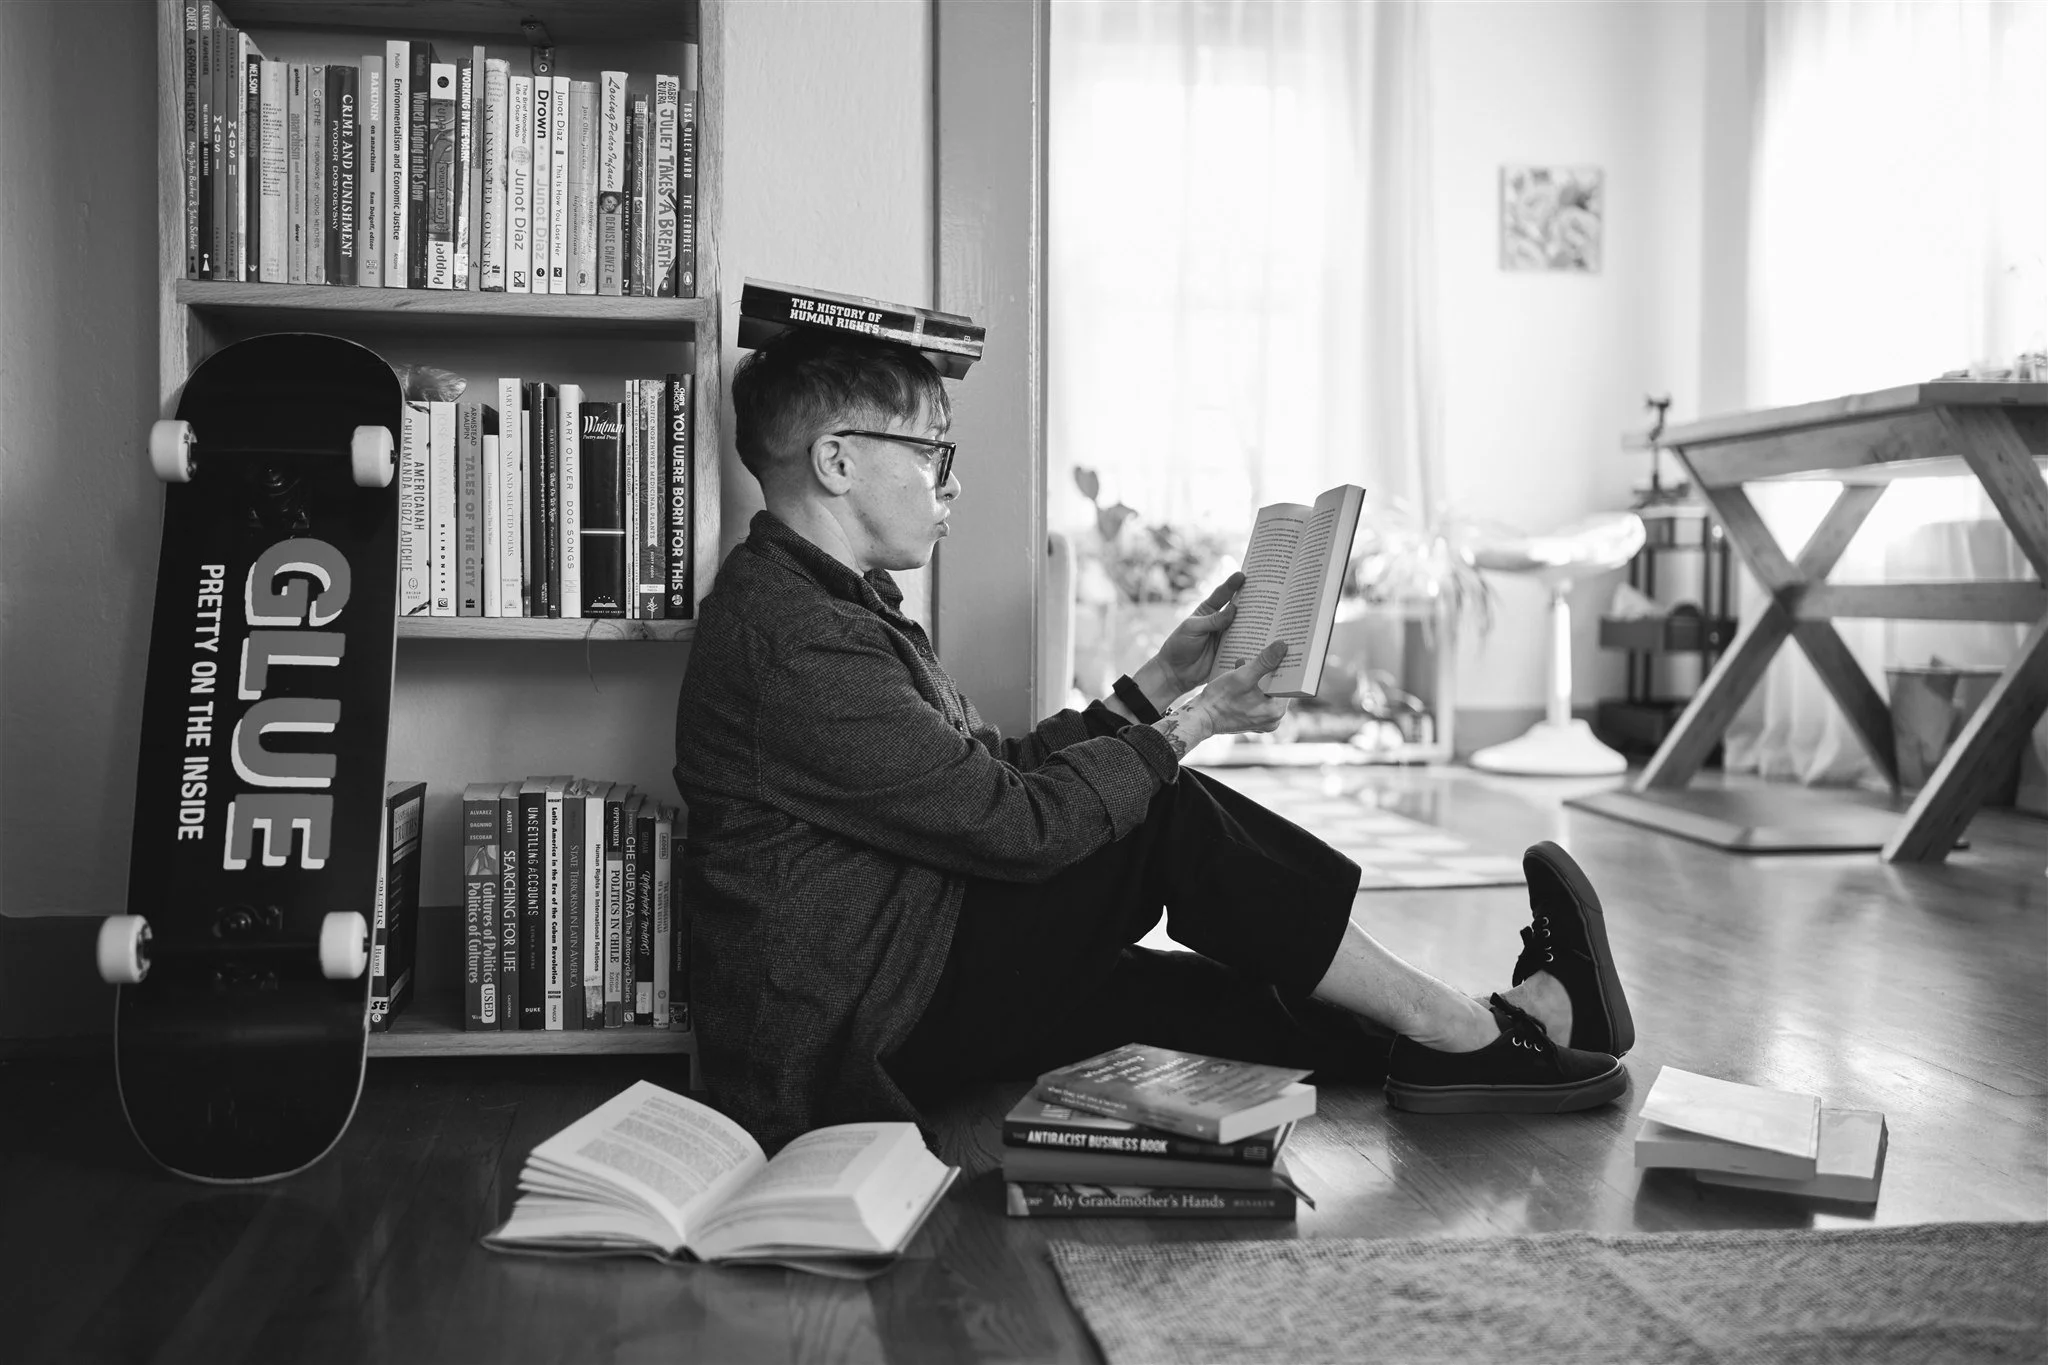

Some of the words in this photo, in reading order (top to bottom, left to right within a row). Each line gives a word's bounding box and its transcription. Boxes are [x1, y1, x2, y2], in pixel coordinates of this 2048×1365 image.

[186, 6, 198, 31] QUEER
[249, 63, 258, 95] NELSON
[461, 67, 471, 110] WORKING
[514, 83, 522, 95] Life
[657, 81, 667, 105] RIVERA
[370, 72, 379, 121] BAKUNIN
[412, 91, 427, 121] Women
[514, 97, 522, 106] of
[556, 91, 566, 117] Junot
[605, 77, 621, 122] Loving
[667, 82, 677, 106] GABBY
[342, 94, 354, 137] CRIME
[393, 78, 403, 152] Environmentalism
[461, 111, 471, 120] IN
[485, 104, 494, 122] MY
[514, 106, 522, 122] Oscar
[537, 90, 549, 139] Drown
[683, 103, 692, 123] YRSA
[214, 114, 222, 152] MAUS
[228, 121, 237, 159] MAUS
[290, 114, 303, 160] anarchism
[370, 125, 376, 134] on
[410, 124, 428, 154] Singing
[461, 121, 471, 139] THE
[514, 124, 522, 138] Wao
[556, 120, 566, 141] Díaz
[607, 123, 618, 151] Pedro
[660, 109, 675, 150] JULIET
[215, 158, 220, 169] I
[342, 141, 353, 169] AND
[369, 136, 377, 173] anarchism
[393, 153, 402, 169] and
[412, 155, 426, 163] in
[461, 139, 471, 162] DARK
[683, 127, 692, 178] DALEY-WARD
[228, 164, 236, 175] II
[412, 165, 427, 179] the
[485, 132, 494, 204] INVENTED
[555, 164, 563, 177] This
[606, 151, 617, 189] Infante
[659, 154, 676, 196] TAKES
[392, 171, 402, 208] Economic
[412, 180, 426, 202] Snow
[514, 168, 527, 214] Junot
[555, 180, 563, 188] Is
[555, 190, 563, 206] How
[535, 178, 548, 222] Junot
[659, 202, 672, 215] A
[683, 195, 692, 209] THE
[341, 174, 353, 258] PUNISHMENT
[392, 211, 401, 241] Justice
[555, 208, 563, 222] You
[514, 217, 528, 251] Díaz
[535, 226, 548, 260] Díaz
[555, 224, 563, 239] Lose
[605, 217, 616, 243] DENISE
[659, 219, 675, 268] BREATH
[683, 213, 692, 253] TERRIBLE
[483, 212, 492, 280] COUNTRY
[555, 243, 563, 256] Her
[605, 245, 616, 273] CHÁVEZ
[432, 242, 447, 285] Puppet
[790, 309, 834, 326] HUMAN
[836, 316, 880, 334] RIGHTS
[791, 298, 814, 310] THE
[817, 302, 865, 320] HISTORY
[868, 312, 882, 324] OF
[505, 385, 513, 408] MARY
[626, 390, 632, 399] ED
[649, 395, 657, 423] PACIFIC
[469, 407, 477, 447] ARMISTEAD
[505, 410, 513, 439] OLIVER
[566, 411, 574, 442] MARY
[672, 413, 686, 441] YOU
[402, 417, 412, 490] CHIMAMANDA
[506, 450, 514, 469] NEW
[649, 426, 657, 469] NORTHWEST
[465, 456, 475, 497] TALES
[566, 447, 574, 491] OLIVER
[672, 444, 686, 484] WERE
[506, 471, 514, 490] AND
[649, 470, 657, 510] MEDICINAL
[401, 494, 412, 527] NGOZI
[413, 461, 425, 531] AMERICANAH
[506, 491, 514, 530] SELECTED
[672, 487, 686, 525] BORN
[465, 502, 475, 521] OF
[566, 500, 574, 525] DOG
[649, 512, 657, 540] PLANTS
[401, 530, 412, 573] ADICHIE
[465, 526, 475, 552] THE
[506, 531, 514, 558] POEMS
[566, 529, 574, 570] SONGS
[672, 530, 686, 557] FOR
[465, 557, 475, 588] CITY
[672, 560, 686, 590] THIS
[194, 564, 225, 653] PRETTY
[190, 661, 217, 694] ON
[224, 538, 351, 870] GLUE
[186, 700, 214, 747] THE
[177, 756, 209, 841] INSIDE
[551, 807, 559, 826] Latin
[612, 807, 621, 847] OPPENHEIM
[527, 807, 539, 865] UNSETTLING
[551, 828, 559, 857] America
[625, 836, 636, 860] CHE
[551, 859, 559, 867] in
[594, 843, 602, 866] Human
[503, 850, 516, 919] SEARCHING
[551, 869, 559, 880] the
[551, 883, 559, 895] Era
[594, 868, 602, 888] Rights
[467, 882, 482, 923] Politics
[482, 882, 496, 927] Cultures
[527, 867, 539, 916] ACCOUNTS
[551, 898, 559, 906] of
[594, 890, 602, 898] in
[610, 870, 621, 916] POLITICS
[625, 863, 636, 919] GUEVARA
[551, 907, 559, 919] the
[594, 899, 602, 938] International
[610, 918, 621, 929] IN
[624, 921, 632, 934] The
[468, 925, 482, 937] of
[482, 929, 495, 939] of
[503, 923, 516, 947] FOR
[551, 921, 559, 944] Cuban
[467, 938, 482, 984] Cultures
[594, 941, 602, 972] Relations
[610, 931, 621, 963] CHILE
[623, 936, 633, 977] Motorcycle
[482, 942, 496, 983] Politics
[503, 951, 516, 973] LIFE
[551, 946, 559, 985] Revolution
[484, 987, 494, 1018] USED
[623, 978, 632, 1004] Diaries
[1027, 1130, 1087, 1147] ANTIRACIST
[1088, 1133, 1138, 1151] BUSINESS
[1140, 1139, 1168, 1154] BOOK
[1053, 1194, 1074, 1210] My
[1077, 1194, 1178, 1208] Grandmother's
[1182, 1195, 1226, 1208] Hands
